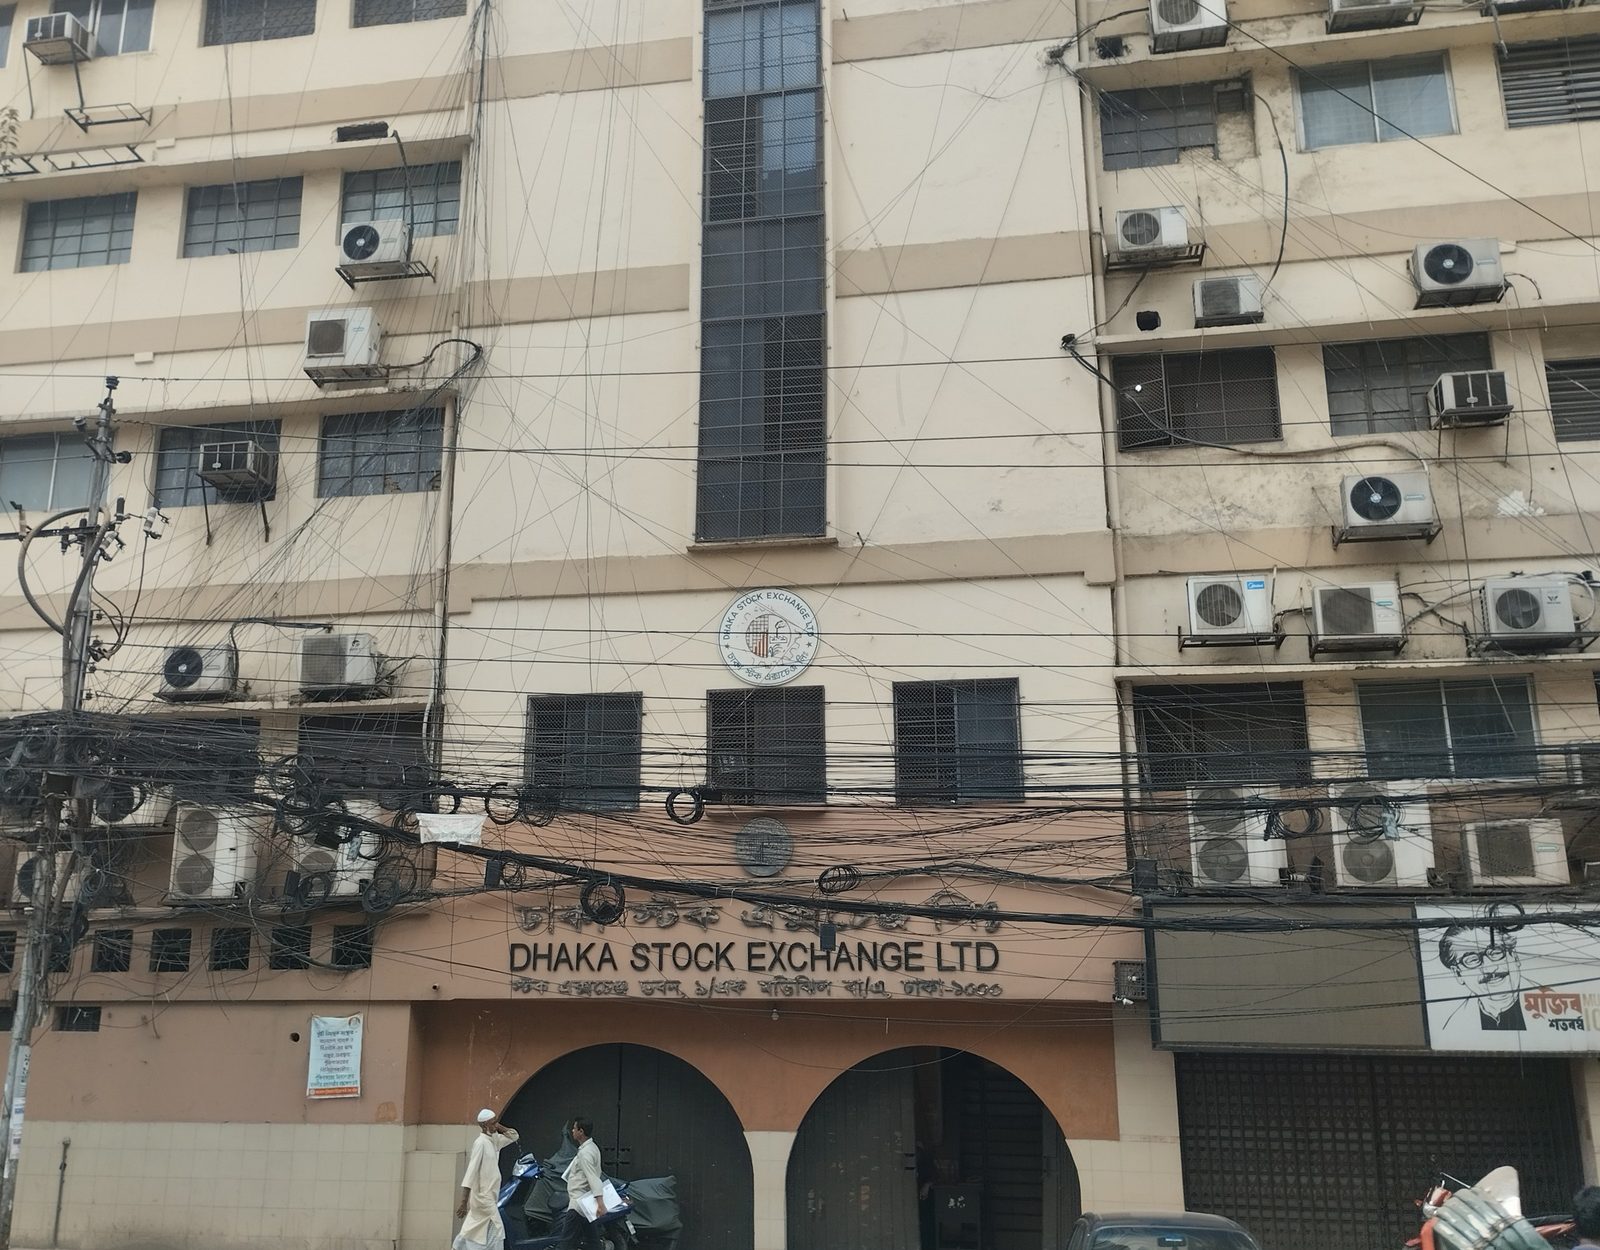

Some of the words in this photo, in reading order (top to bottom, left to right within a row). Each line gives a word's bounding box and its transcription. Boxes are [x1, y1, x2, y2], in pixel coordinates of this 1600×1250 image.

[723, 611, 738, 640] DHAKA
[737, 592, 763, 611] STOCK
[766, 592, 810, 620] EXCHANGE
[510, 942, 618, 972] DHAKA
[630, 942, 735, 972] STOCK
[747, 941, 925, 972] EXCHANGE
[936, 941, 999, 972] LTD
[1523, 986, 1583, 1020] মুজিব
[1548, 1015, 1585, 1032] শতবর্ষ
